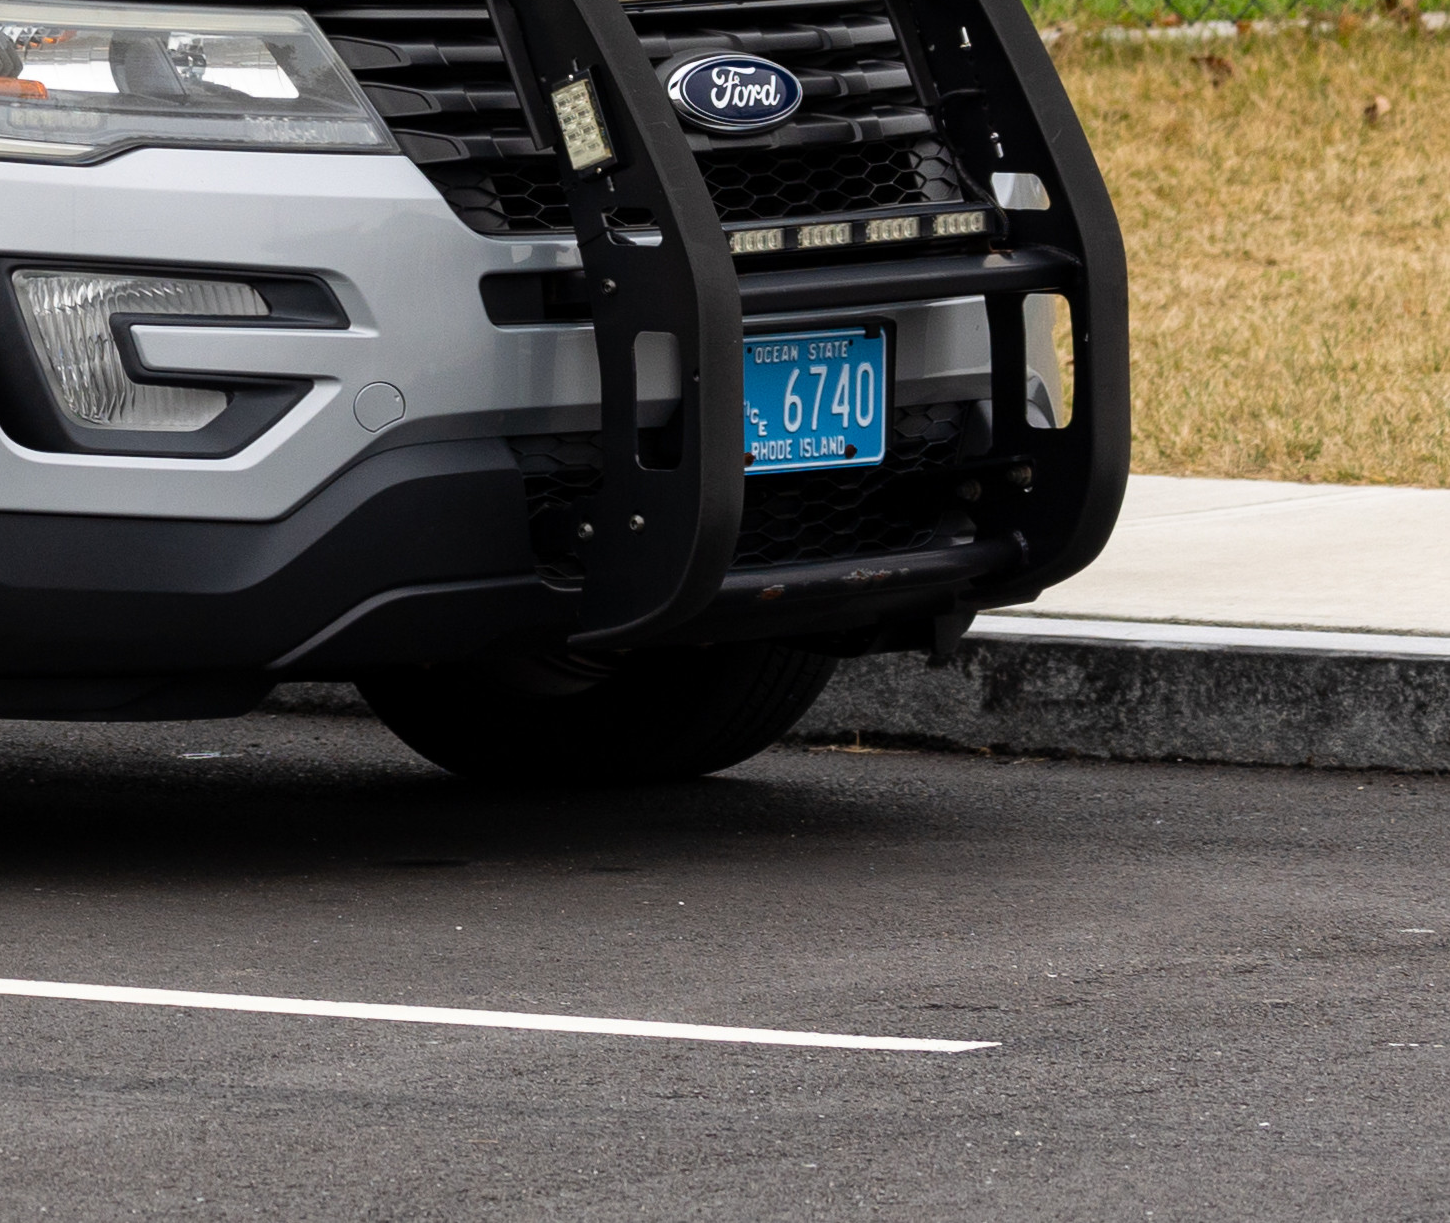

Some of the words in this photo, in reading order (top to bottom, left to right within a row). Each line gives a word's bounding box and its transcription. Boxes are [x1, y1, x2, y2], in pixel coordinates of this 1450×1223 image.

[710, 65, 781, 110] Ford
[755, 345, 799, 364] OCEAN
[808, 340, 849, 360] STATE
[783, 361, 875, 433] 6740
[751, 438, 793, 461] RHODE
[799, 435, 846, 458] ISLAND
